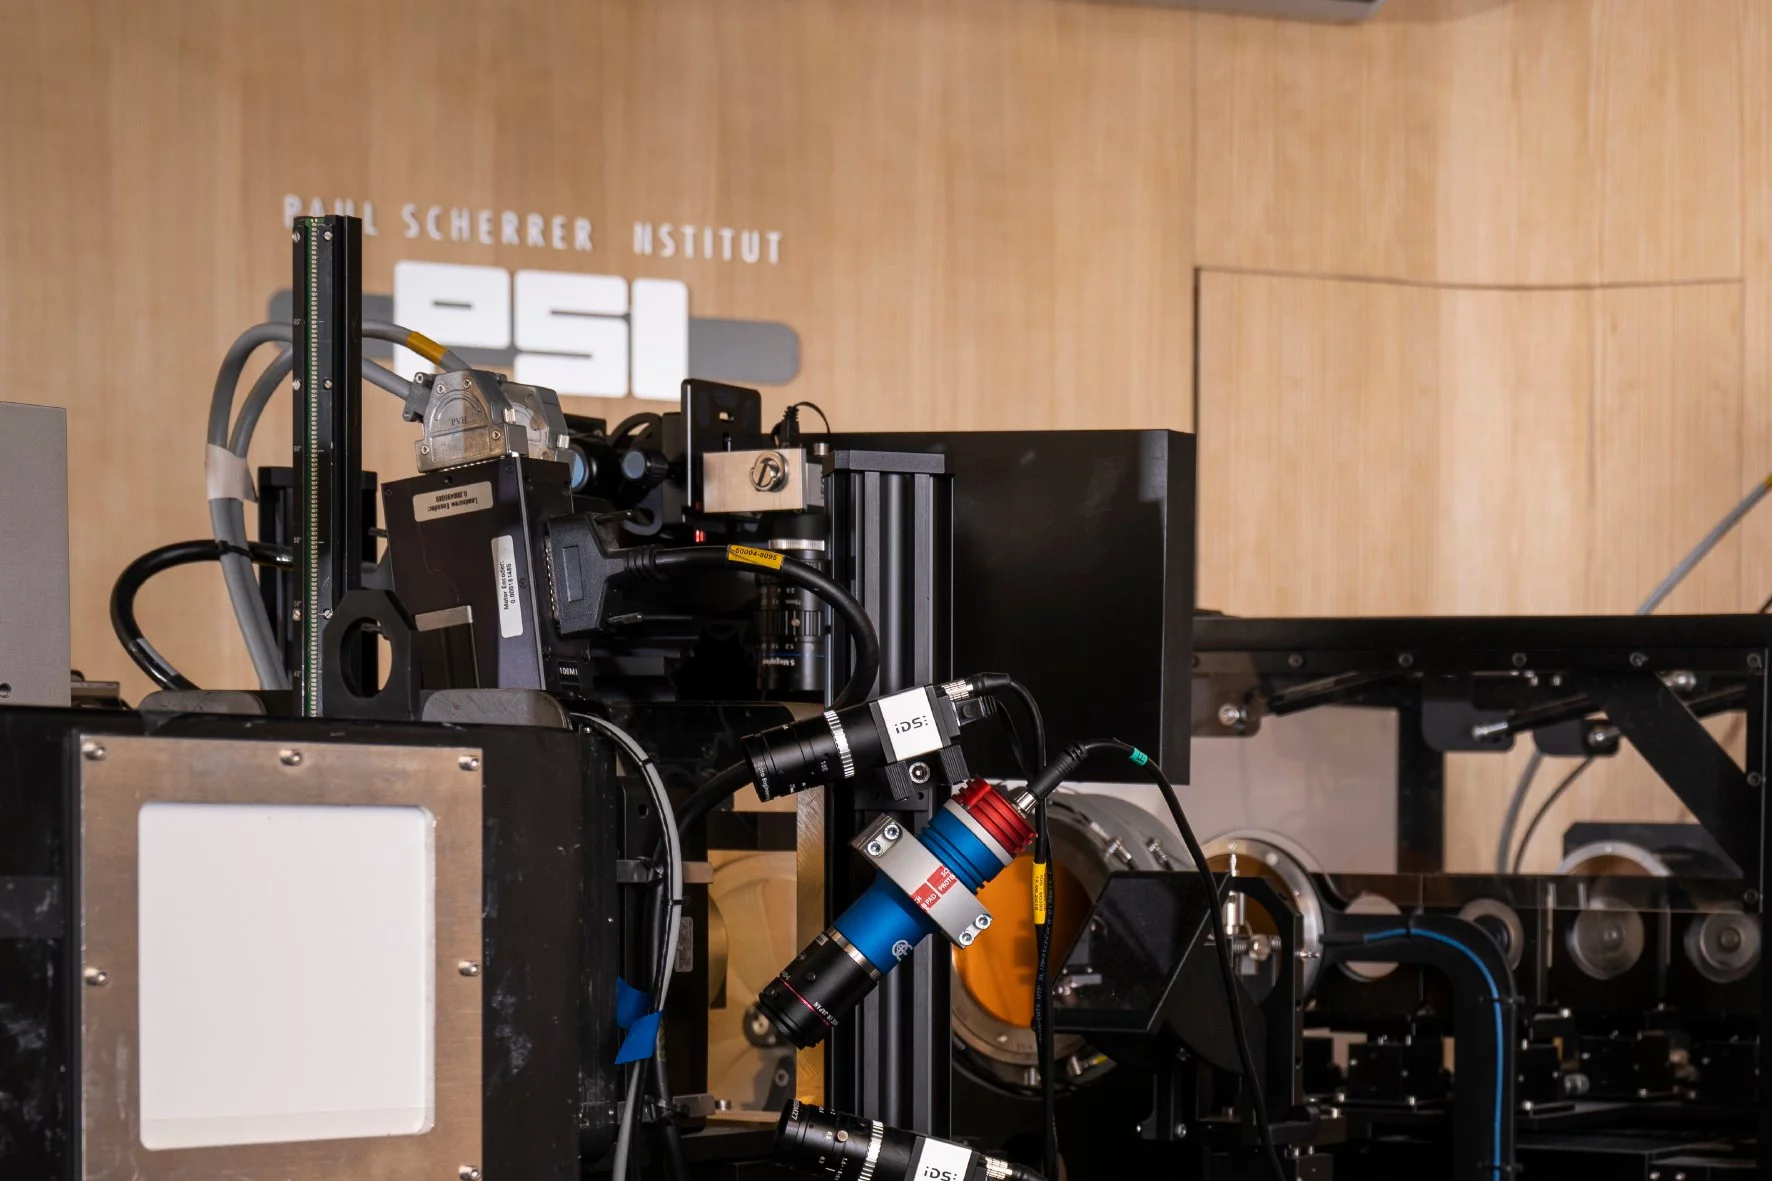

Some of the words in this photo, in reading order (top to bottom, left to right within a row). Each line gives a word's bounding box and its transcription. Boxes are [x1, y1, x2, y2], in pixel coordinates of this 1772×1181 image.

[402, 204, 593, 252] SCHERRER
[393, 259, 690, 401] PSI
[451, 416, 468, 427] PVH
[813, 1001, 830, 1017] JAPAN
